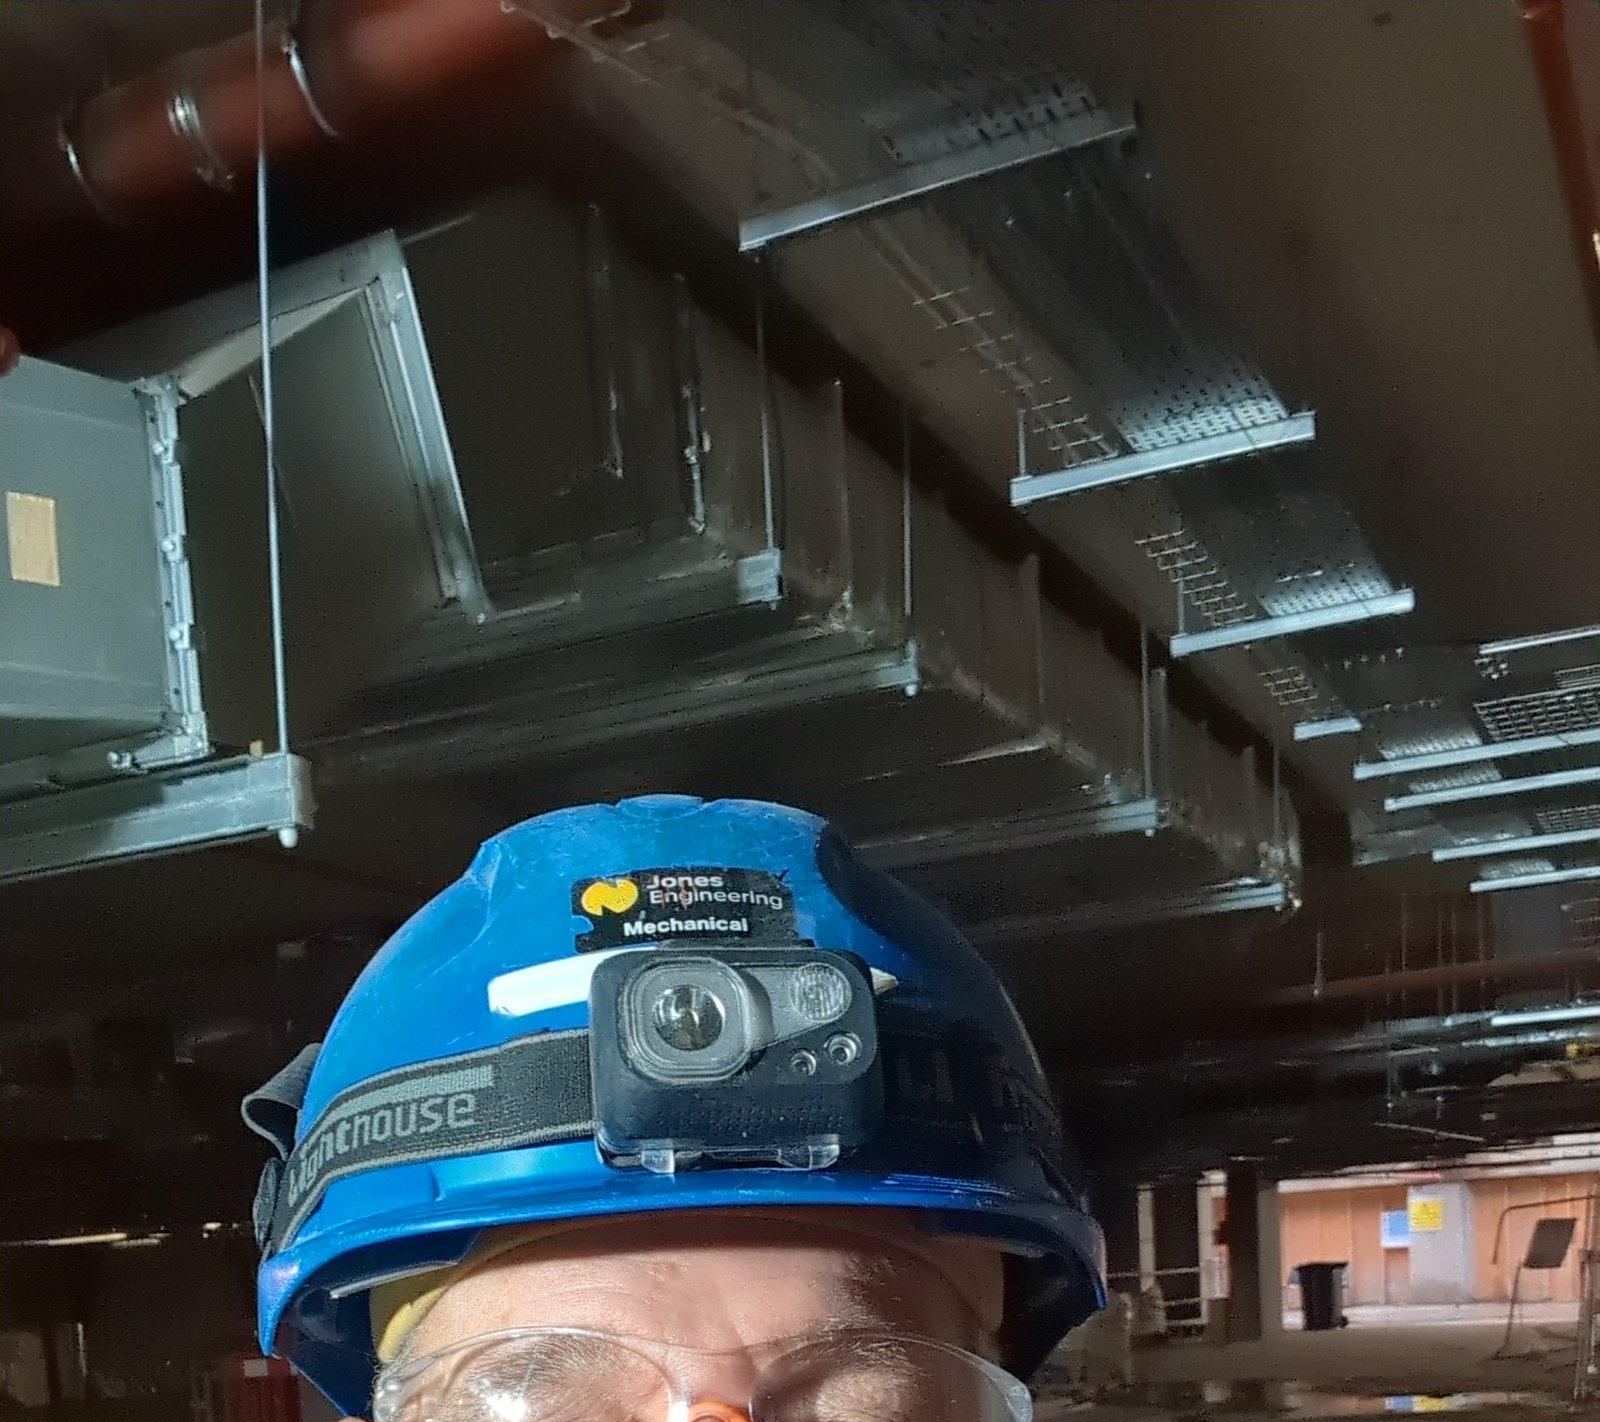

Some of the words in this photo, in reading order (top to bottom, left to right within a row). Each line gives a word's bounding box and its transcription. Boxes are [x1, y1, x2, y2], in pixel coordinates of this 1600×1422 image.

[646, 874, 724, 889] Jones
[649, 889, 783, 910] Engineering
[623, 916, 748, 936] Mechanical
